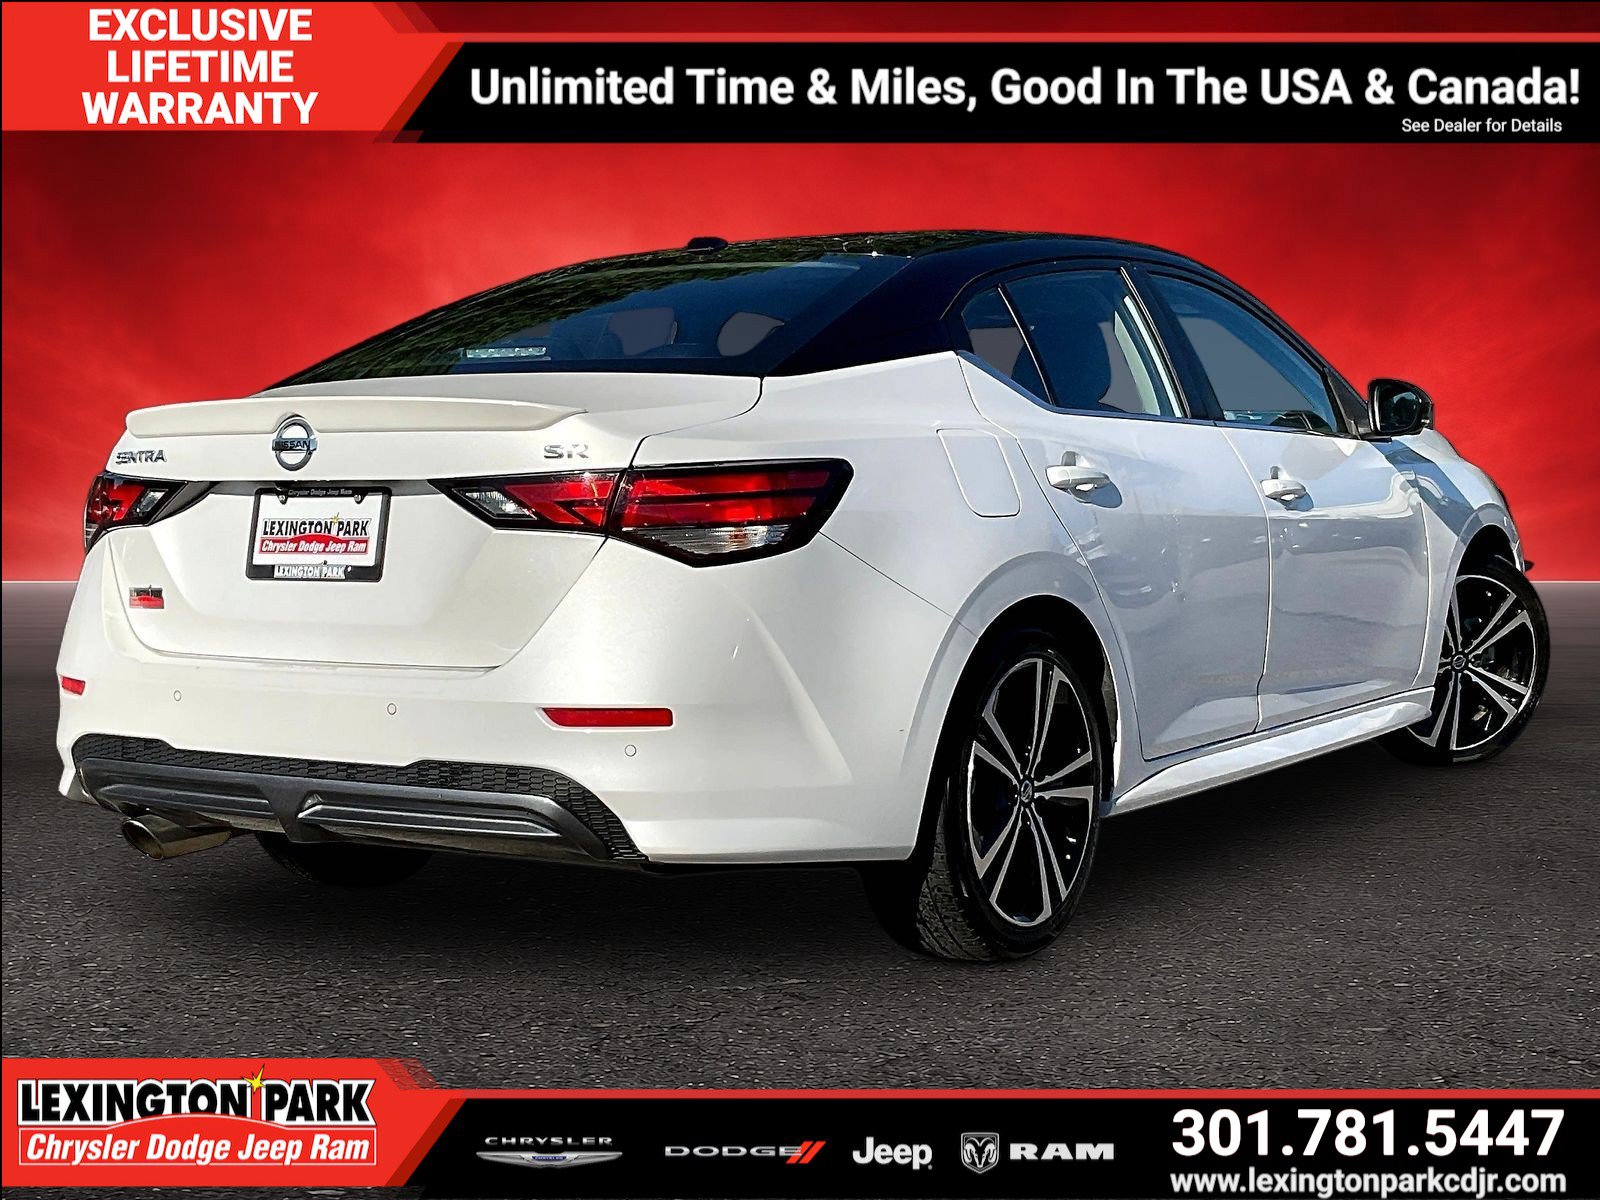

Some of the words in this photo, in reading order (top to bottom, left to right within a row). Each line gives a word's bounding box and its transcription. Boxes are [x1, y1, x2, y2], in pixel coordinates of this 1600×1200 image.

[274, 440, 311, 450] NISSAN
[543, 444, 590, 459] SR
[115, 449, 167, 465] SENTRA
[263, 520, 332, 536] LEXINGTON
[337, 520, 369, 536] PARK
[262, 540, 298, 553] Chrysler
[298, 540, 325, 554] Dodge
[325, 540, 347, 554] Jeep
[347, 541, 367, 552] Ram
[275, 564, 321, 578] LEXINGTON
[321, 565, 345, 578] PARK
